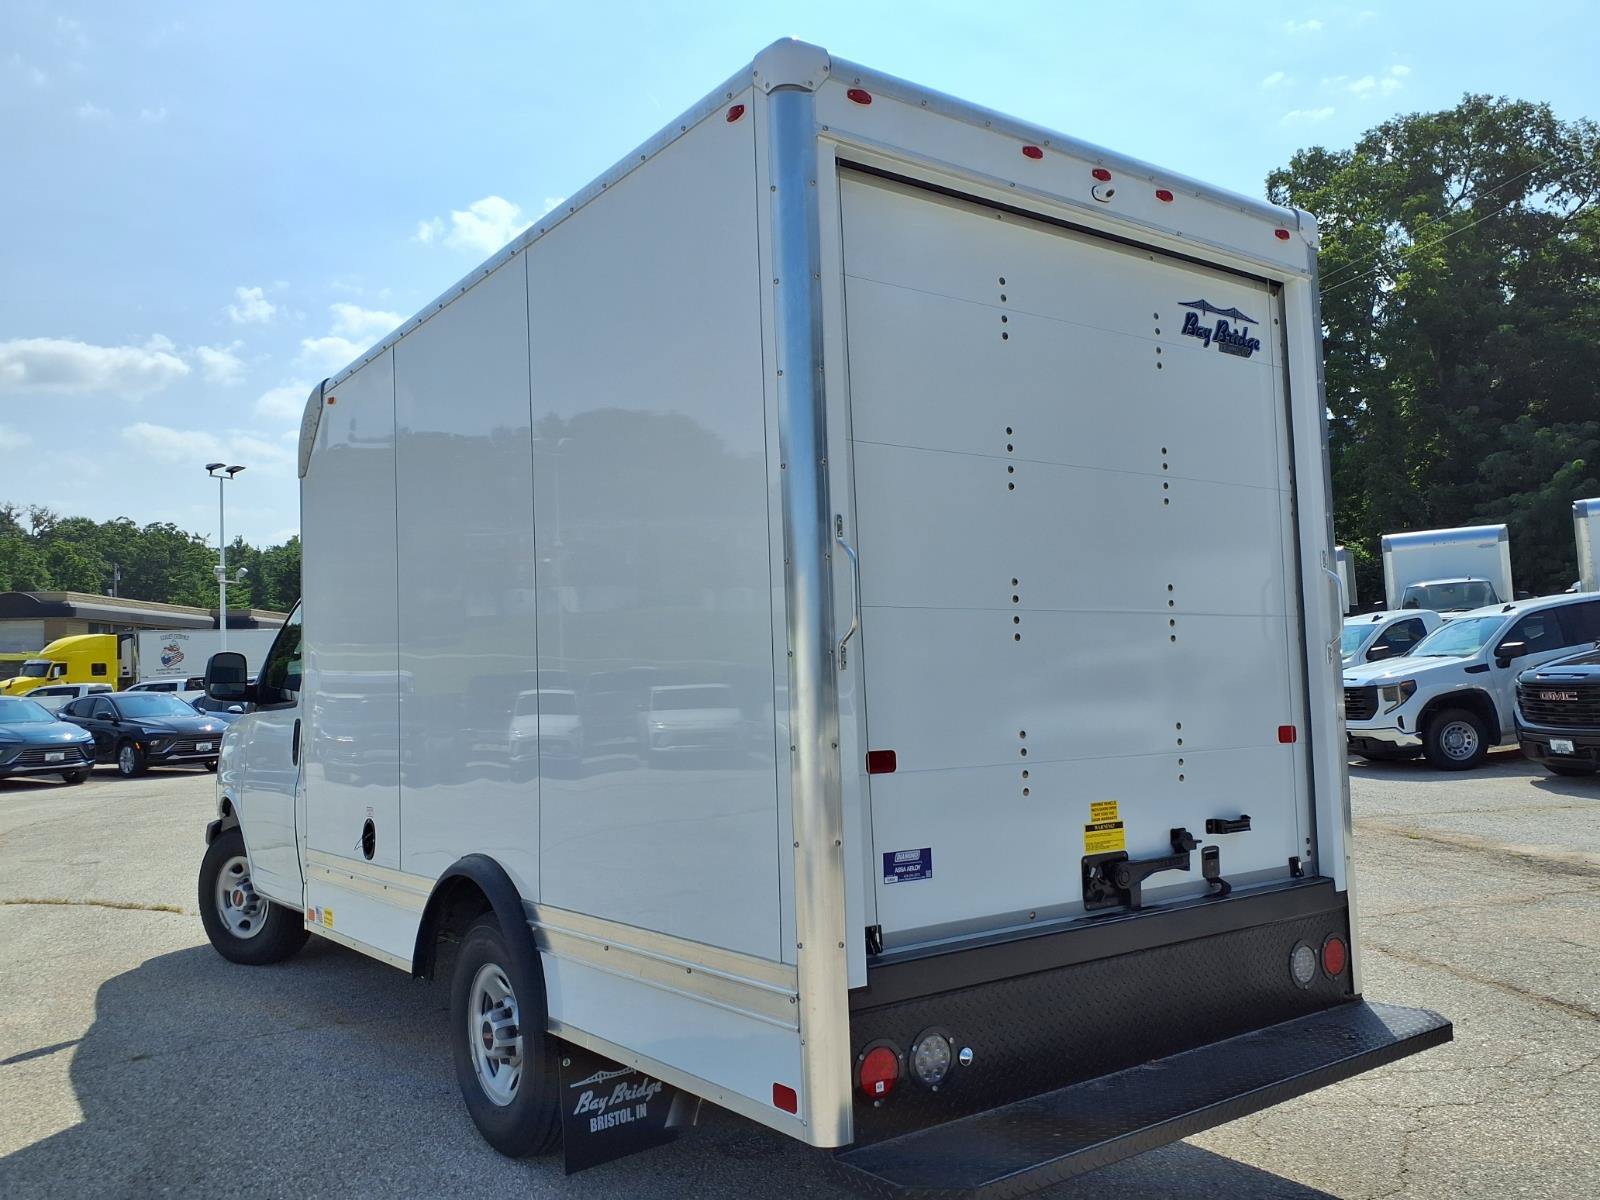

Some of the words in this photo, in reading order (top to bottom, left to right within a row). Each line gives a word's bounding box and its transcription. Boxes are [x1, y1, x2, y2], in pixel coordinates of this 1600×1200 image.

[1181, 312, 1212, 348] Bay
[1212, 319, 1260, 356] Bridge
[1539, 691, 1578, 701] GMC
[907, 864, 921, 872] ABLOY
[573, 1090, 609, 1115] Bay
[608, 1077, 663, 1106] Bridge
[590, 1107, 635, 1133] BRISTOL,
[636, 1103, 647, 1119] IN
